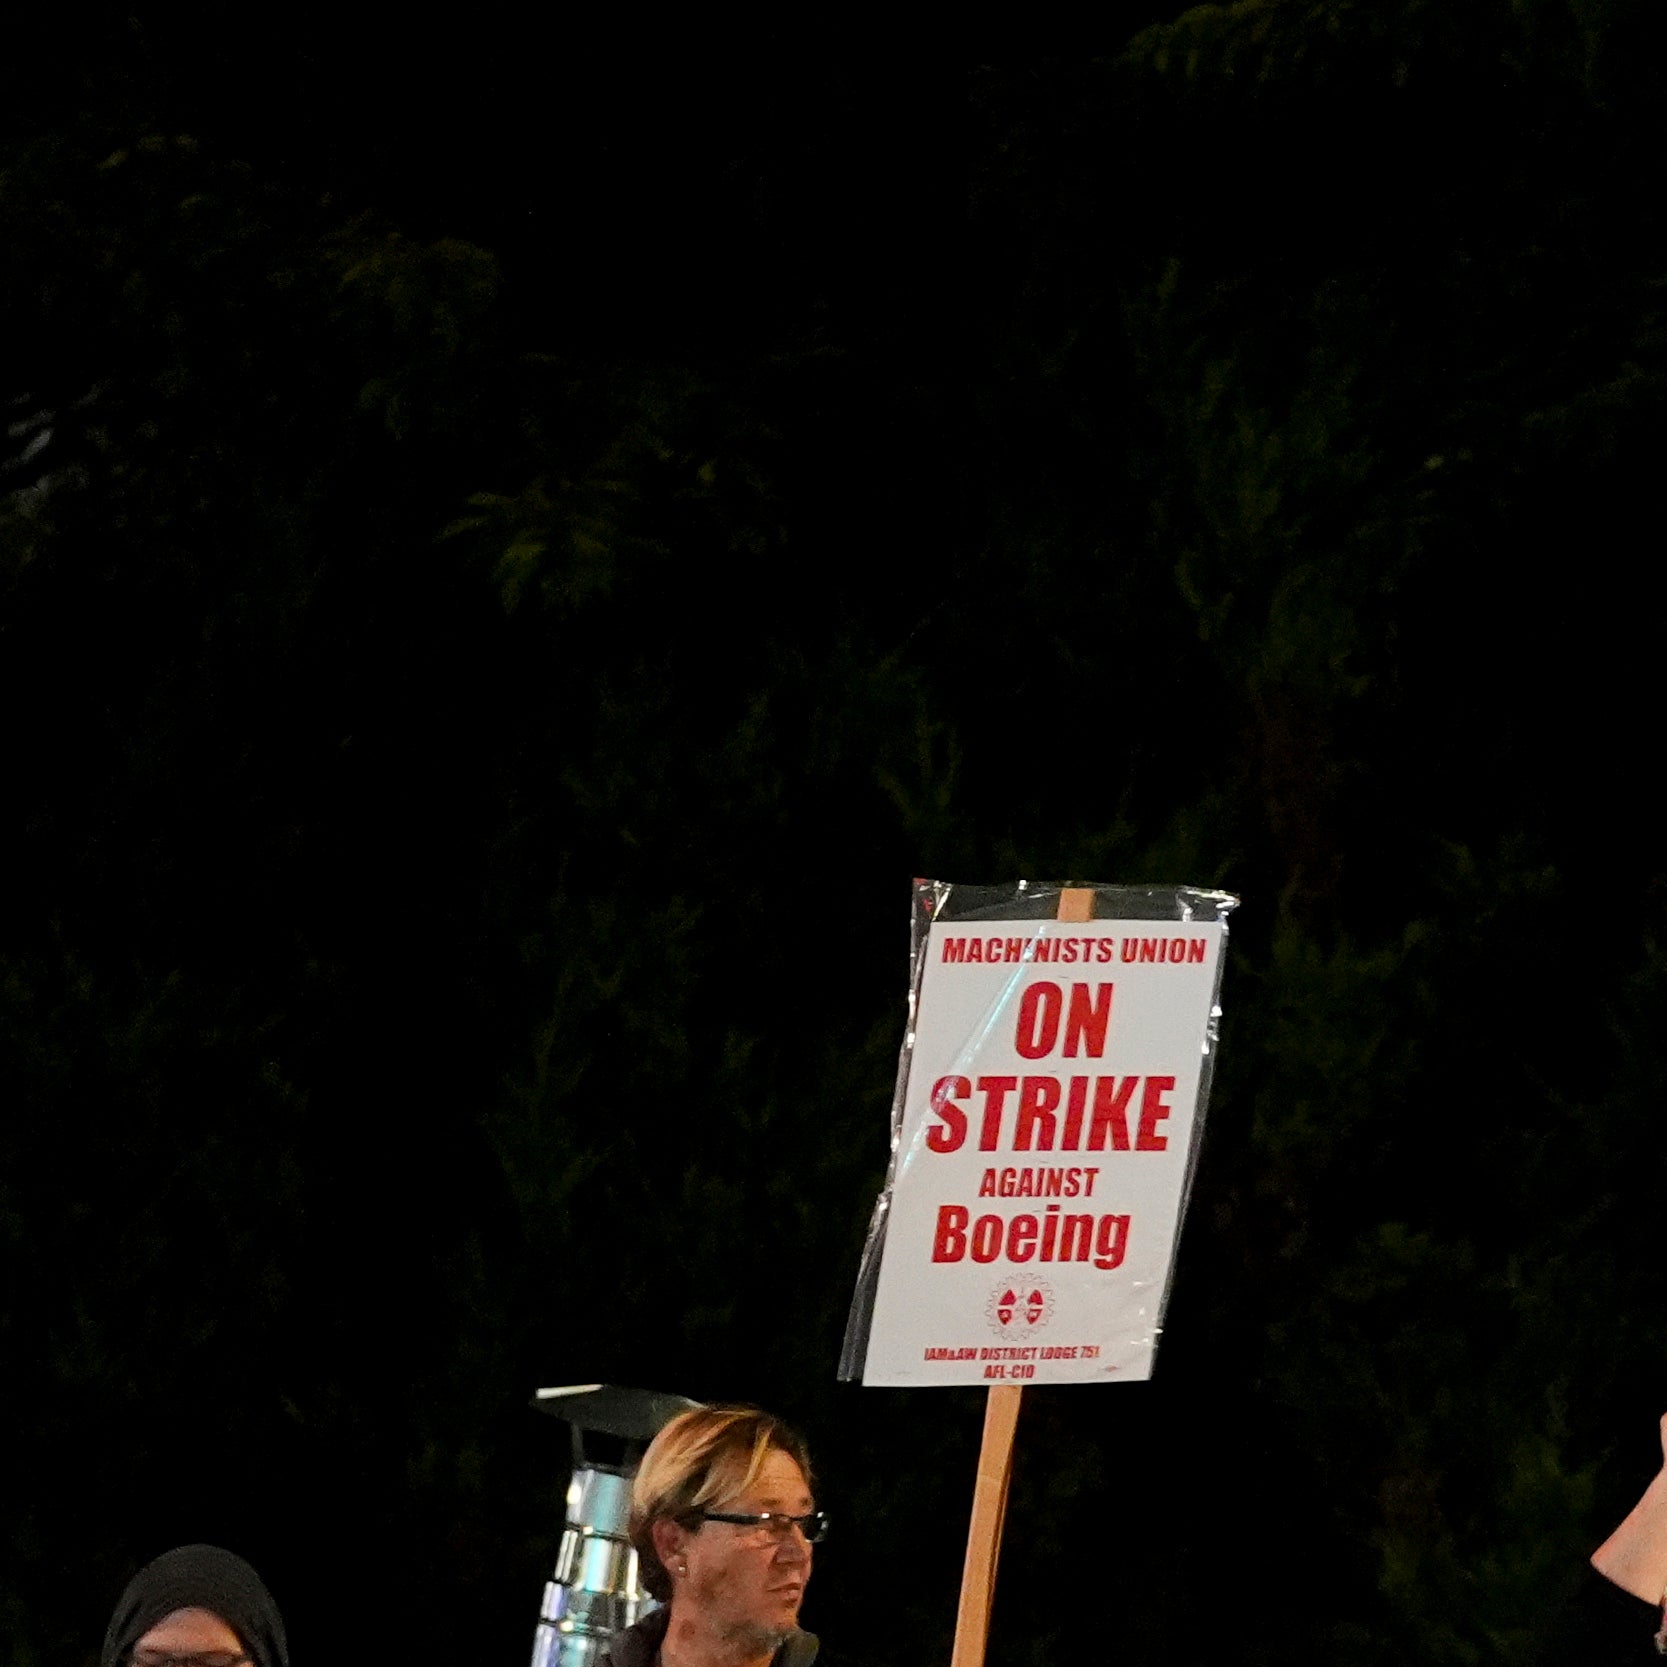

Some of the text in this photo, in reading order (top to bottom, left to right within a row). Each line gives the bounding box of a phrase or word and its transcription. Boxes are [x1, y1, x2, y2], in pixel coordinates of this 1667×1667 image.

[941, 938, 1207, 964] MACHINISTS UNION
[1015, 981, 1112, 1059] ON
[926, 1074, 1176, 1152] STRIKE
[979, 1167, 1099, 1197] AGAINST
[931, 1204, 1131, 1270] Boeing
[980, 1347, 1037, 1360] DISTRICT
[1039, 1346, 1077, 1360] LODGE
[1080, 1346, 1100, 1358] 751
[984, 1364, 1036, 1379] AFL-CIO
